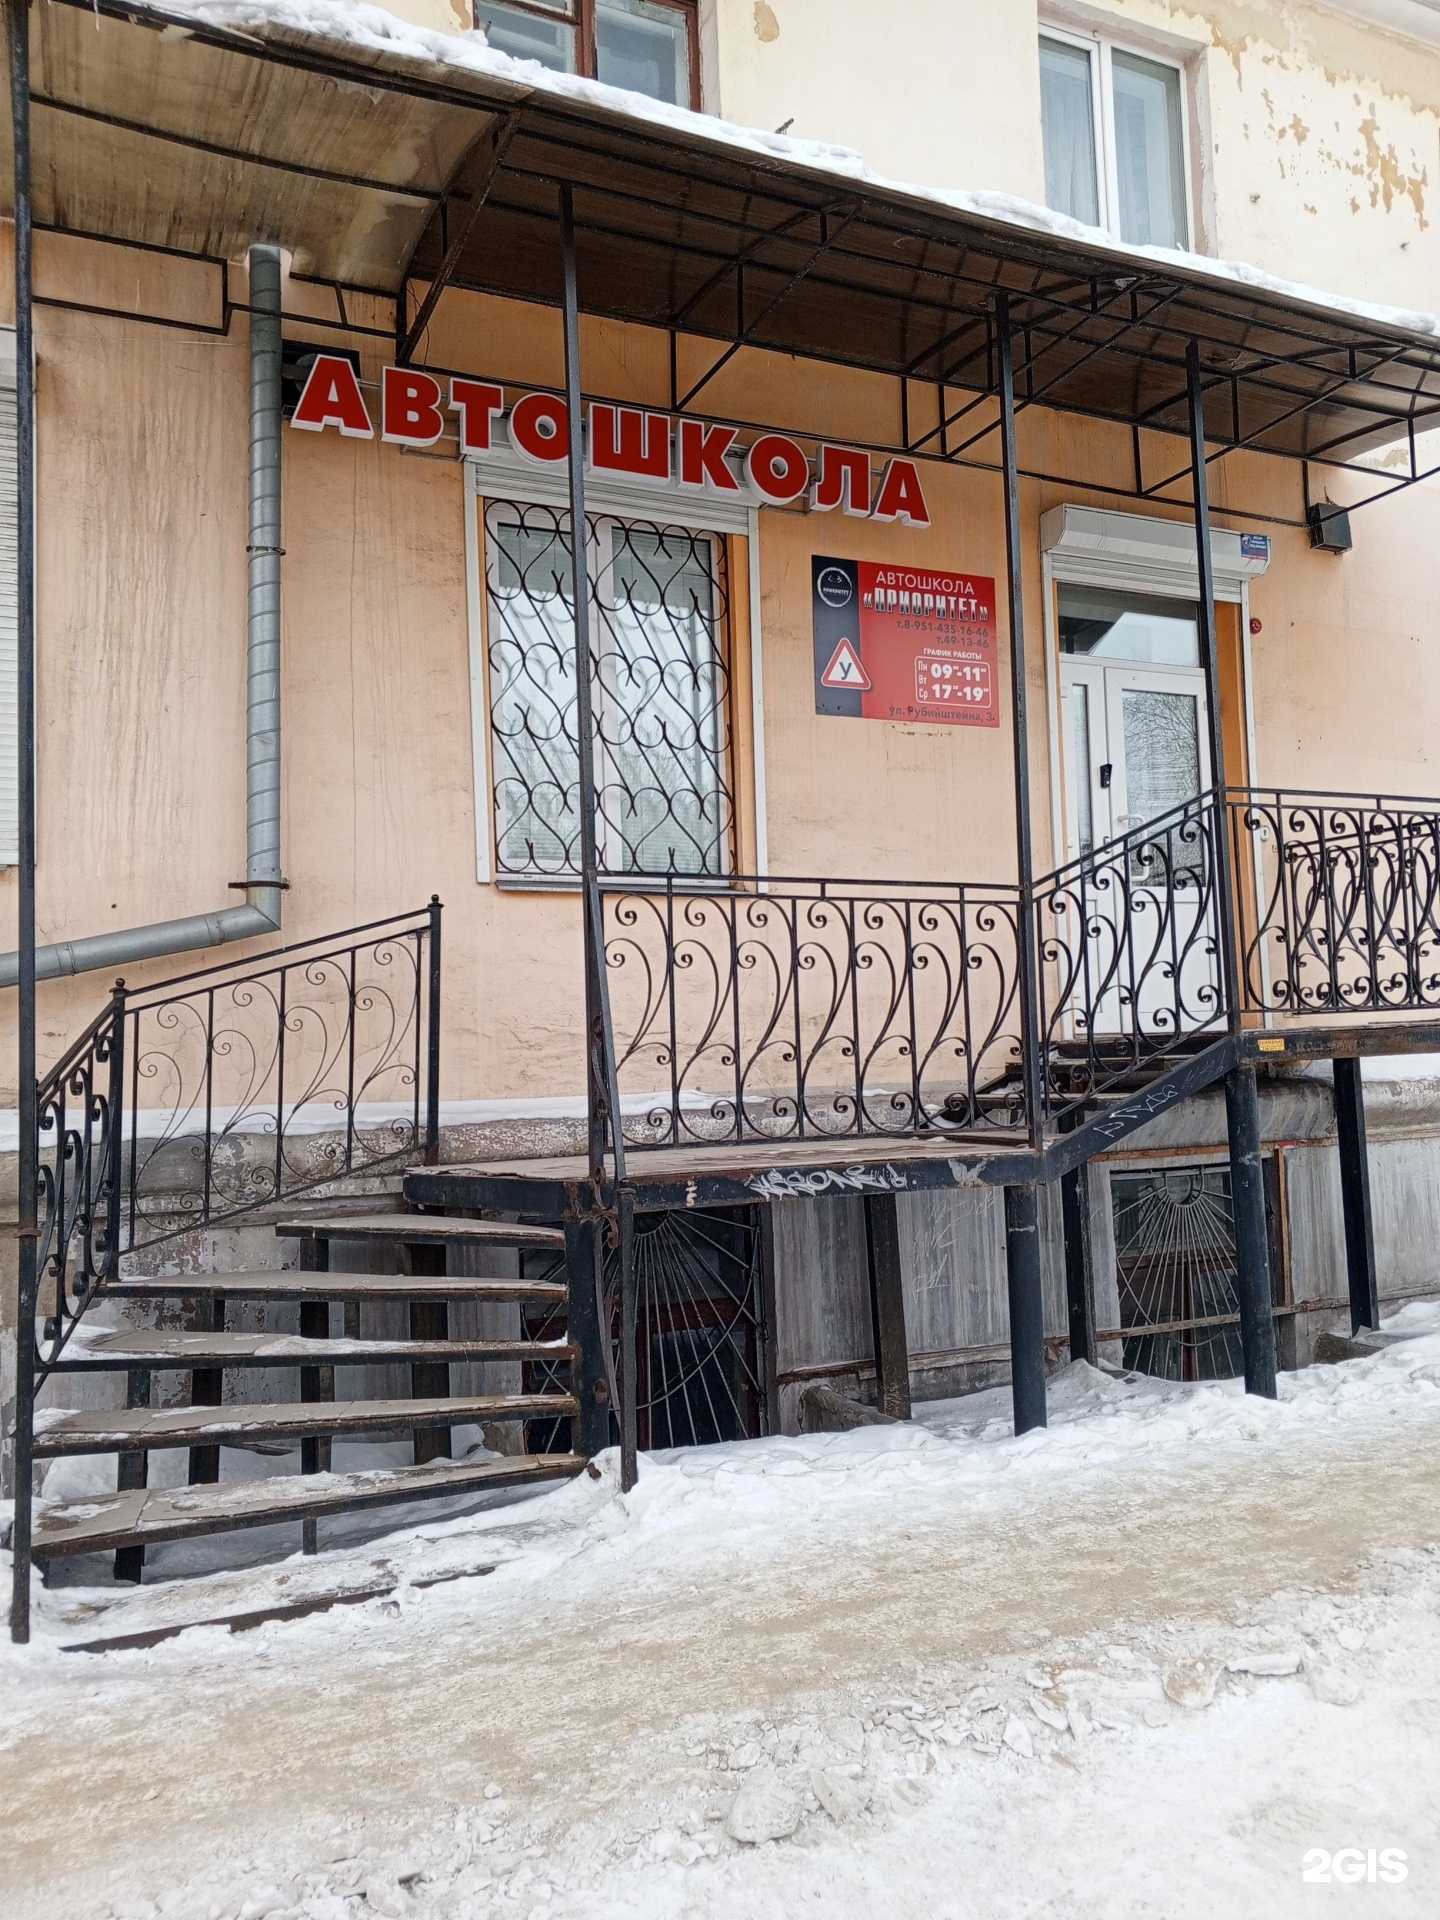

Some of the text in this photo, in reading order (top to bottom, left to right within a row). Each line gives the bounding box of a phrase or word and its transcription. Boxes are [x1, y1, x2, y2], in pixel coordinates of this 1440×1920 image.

[290, 354, 931, 528] АВТОШКОЛА
[876, 571, 975, 595] АВТОШКОЛА
[863, 587, 989, 622] «ПРИОРИТЕТ»
[923, 648, 982, 660] ГРАФИК РАБОТЫ
[839, 662, 852, 680] У
[917, 661, 928, 672] Пн
[918, 674, 928, 685] Вт
[919, 687, 928, 701] Ср
